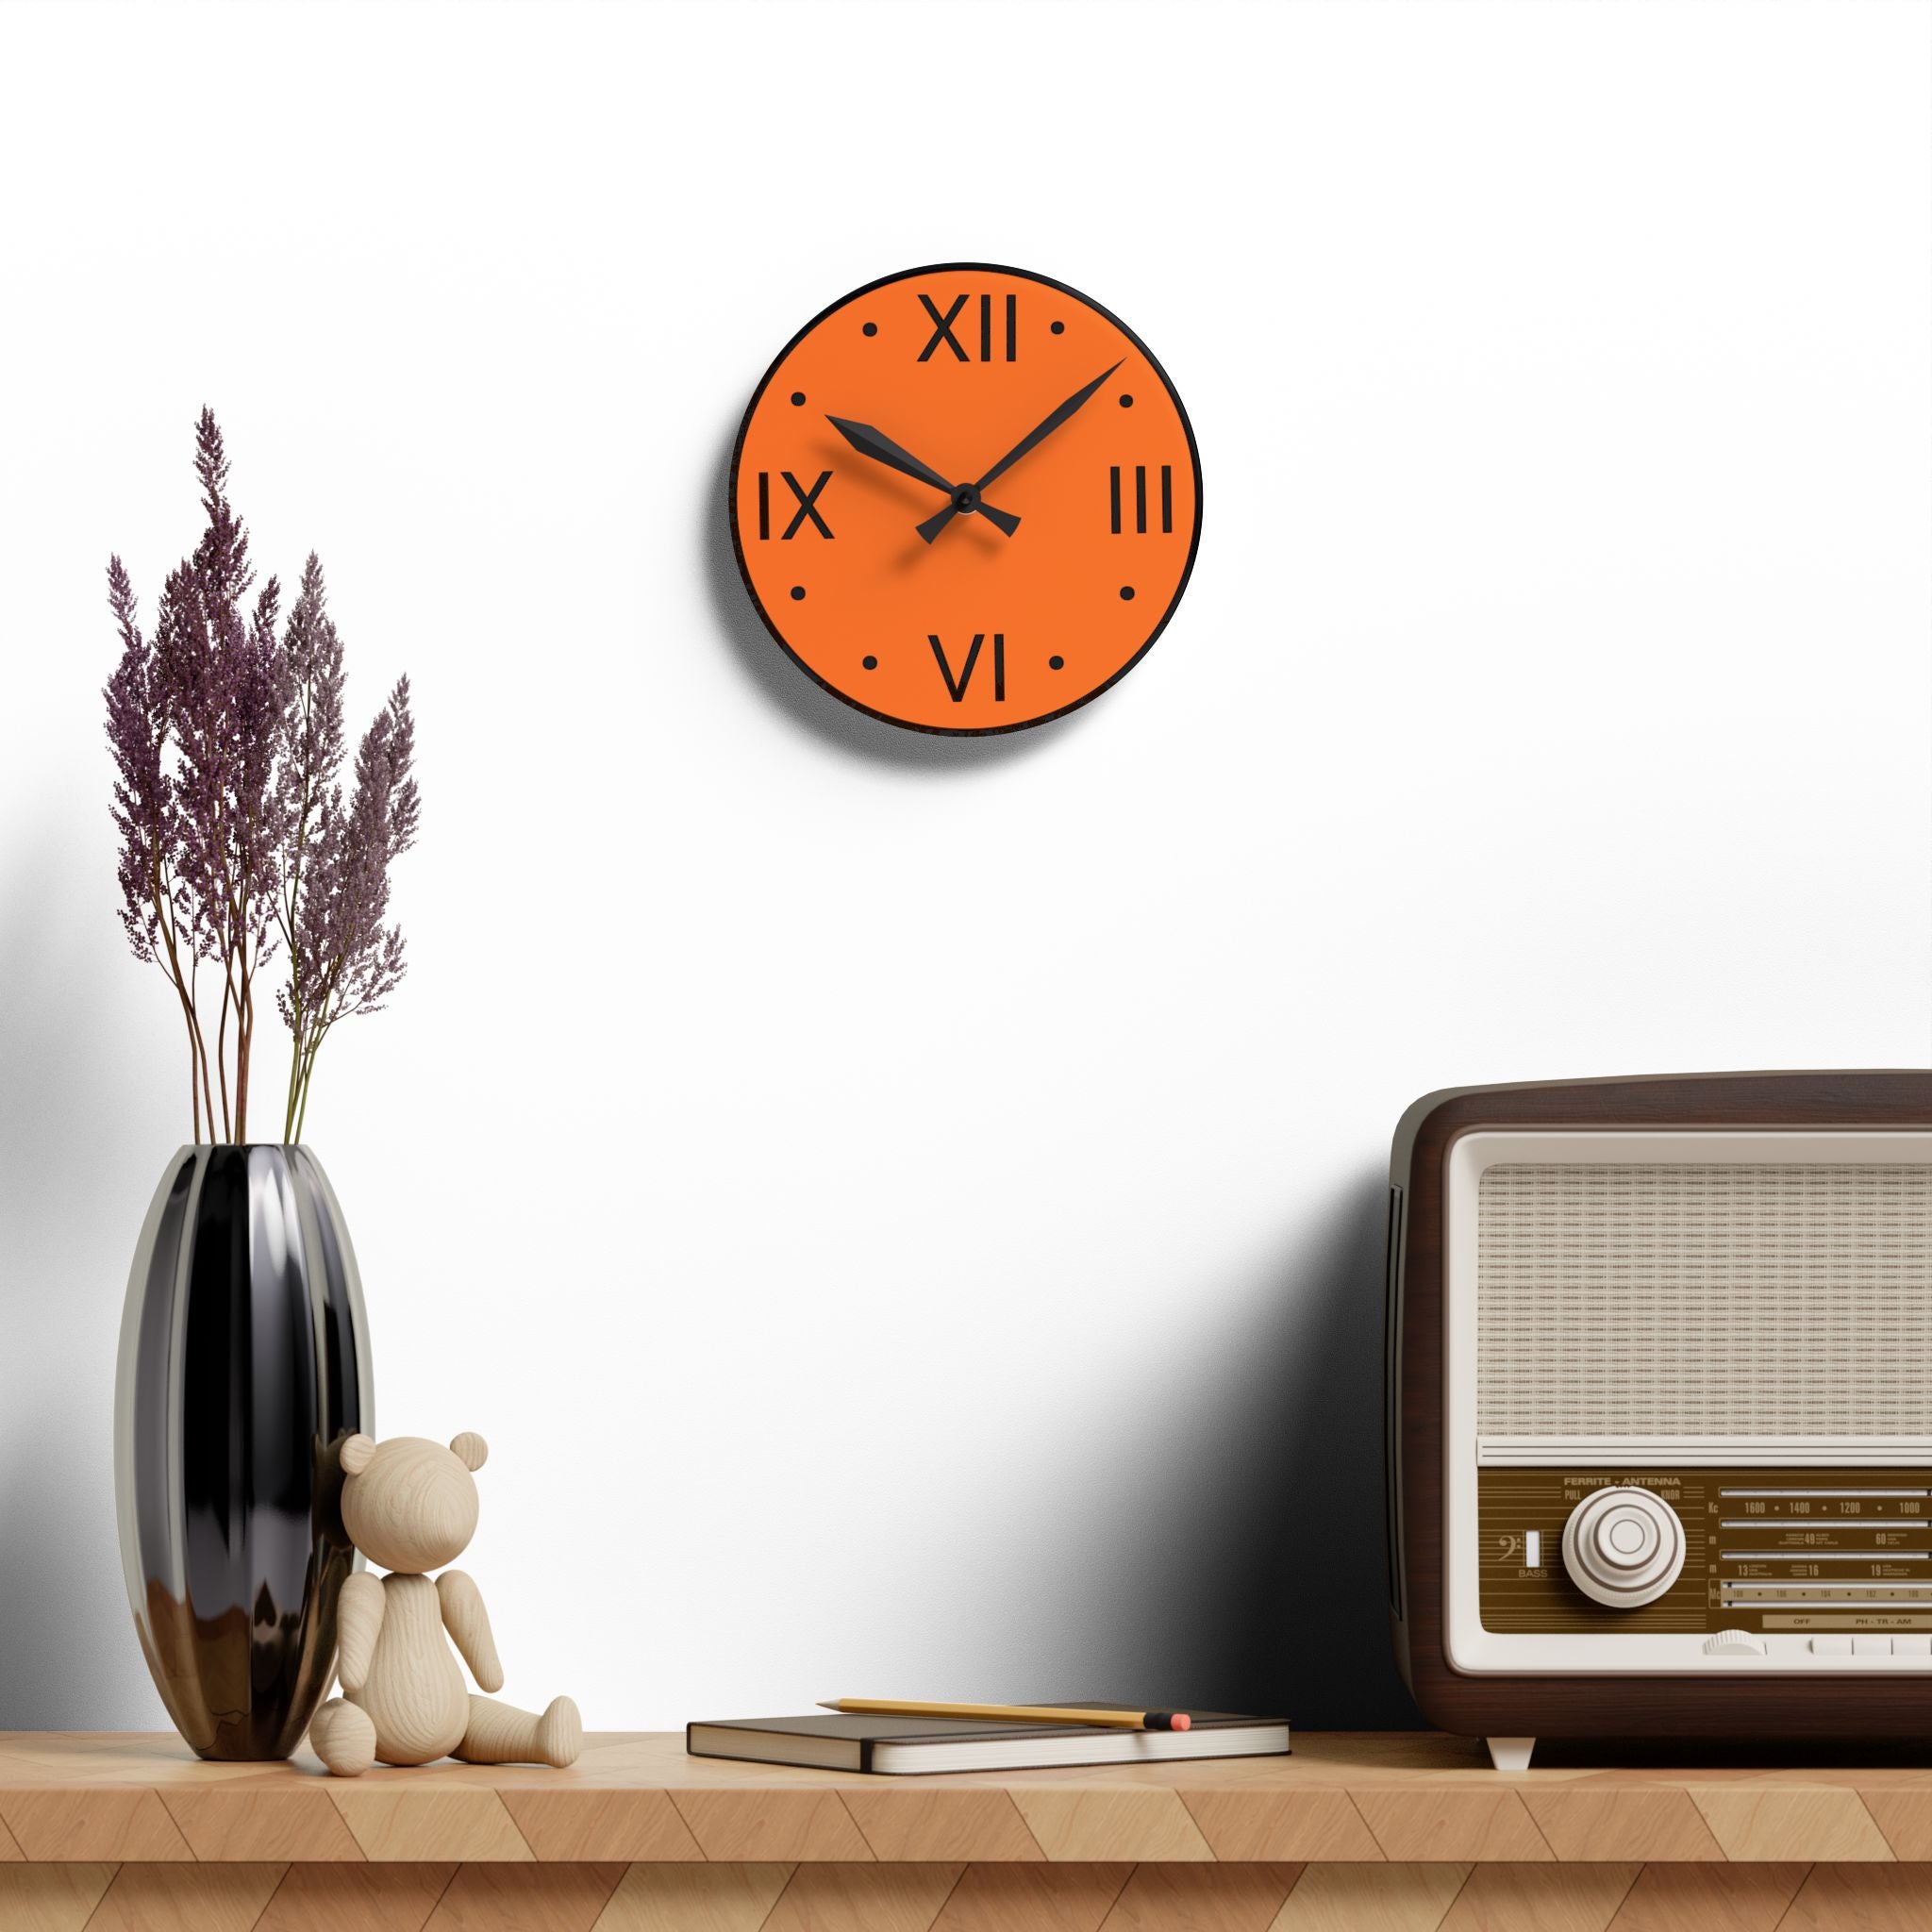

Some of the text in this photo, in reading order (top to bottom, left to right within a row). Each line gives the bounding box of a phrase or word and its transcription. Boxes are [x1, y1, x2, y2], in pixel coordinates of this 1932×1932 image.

[916, 293, 1016, 362] XII
[1110, 465, 1173, 534] III
[758, 471, 835, 541] IX
[927, 633, 1006, 702] VI
[1564, 1477, 1611, 1486] FERRITE
[1623, 1477, 1681, 1486] ANTENNA
[1564, 1490, 1581, 1500] PULL
[1744, 1502, 1766, 1514] 1600
[1790, 1502, 1810, 1514] 1400
[1840, 1502, 1860, 1514] 1200
[1899, 1502, 1921, 1514] 1000
[1805, 1533, 1816, 1545] 49
[1875, 1533, 1887, 1545] 60
[1518, 1569, 1548, 1578] BASS
[1738, 1564, 1749, 1576] 13
[1808, 1564, 1819, 1576] 16
[1871, 1564, 1882, 1576] 19
